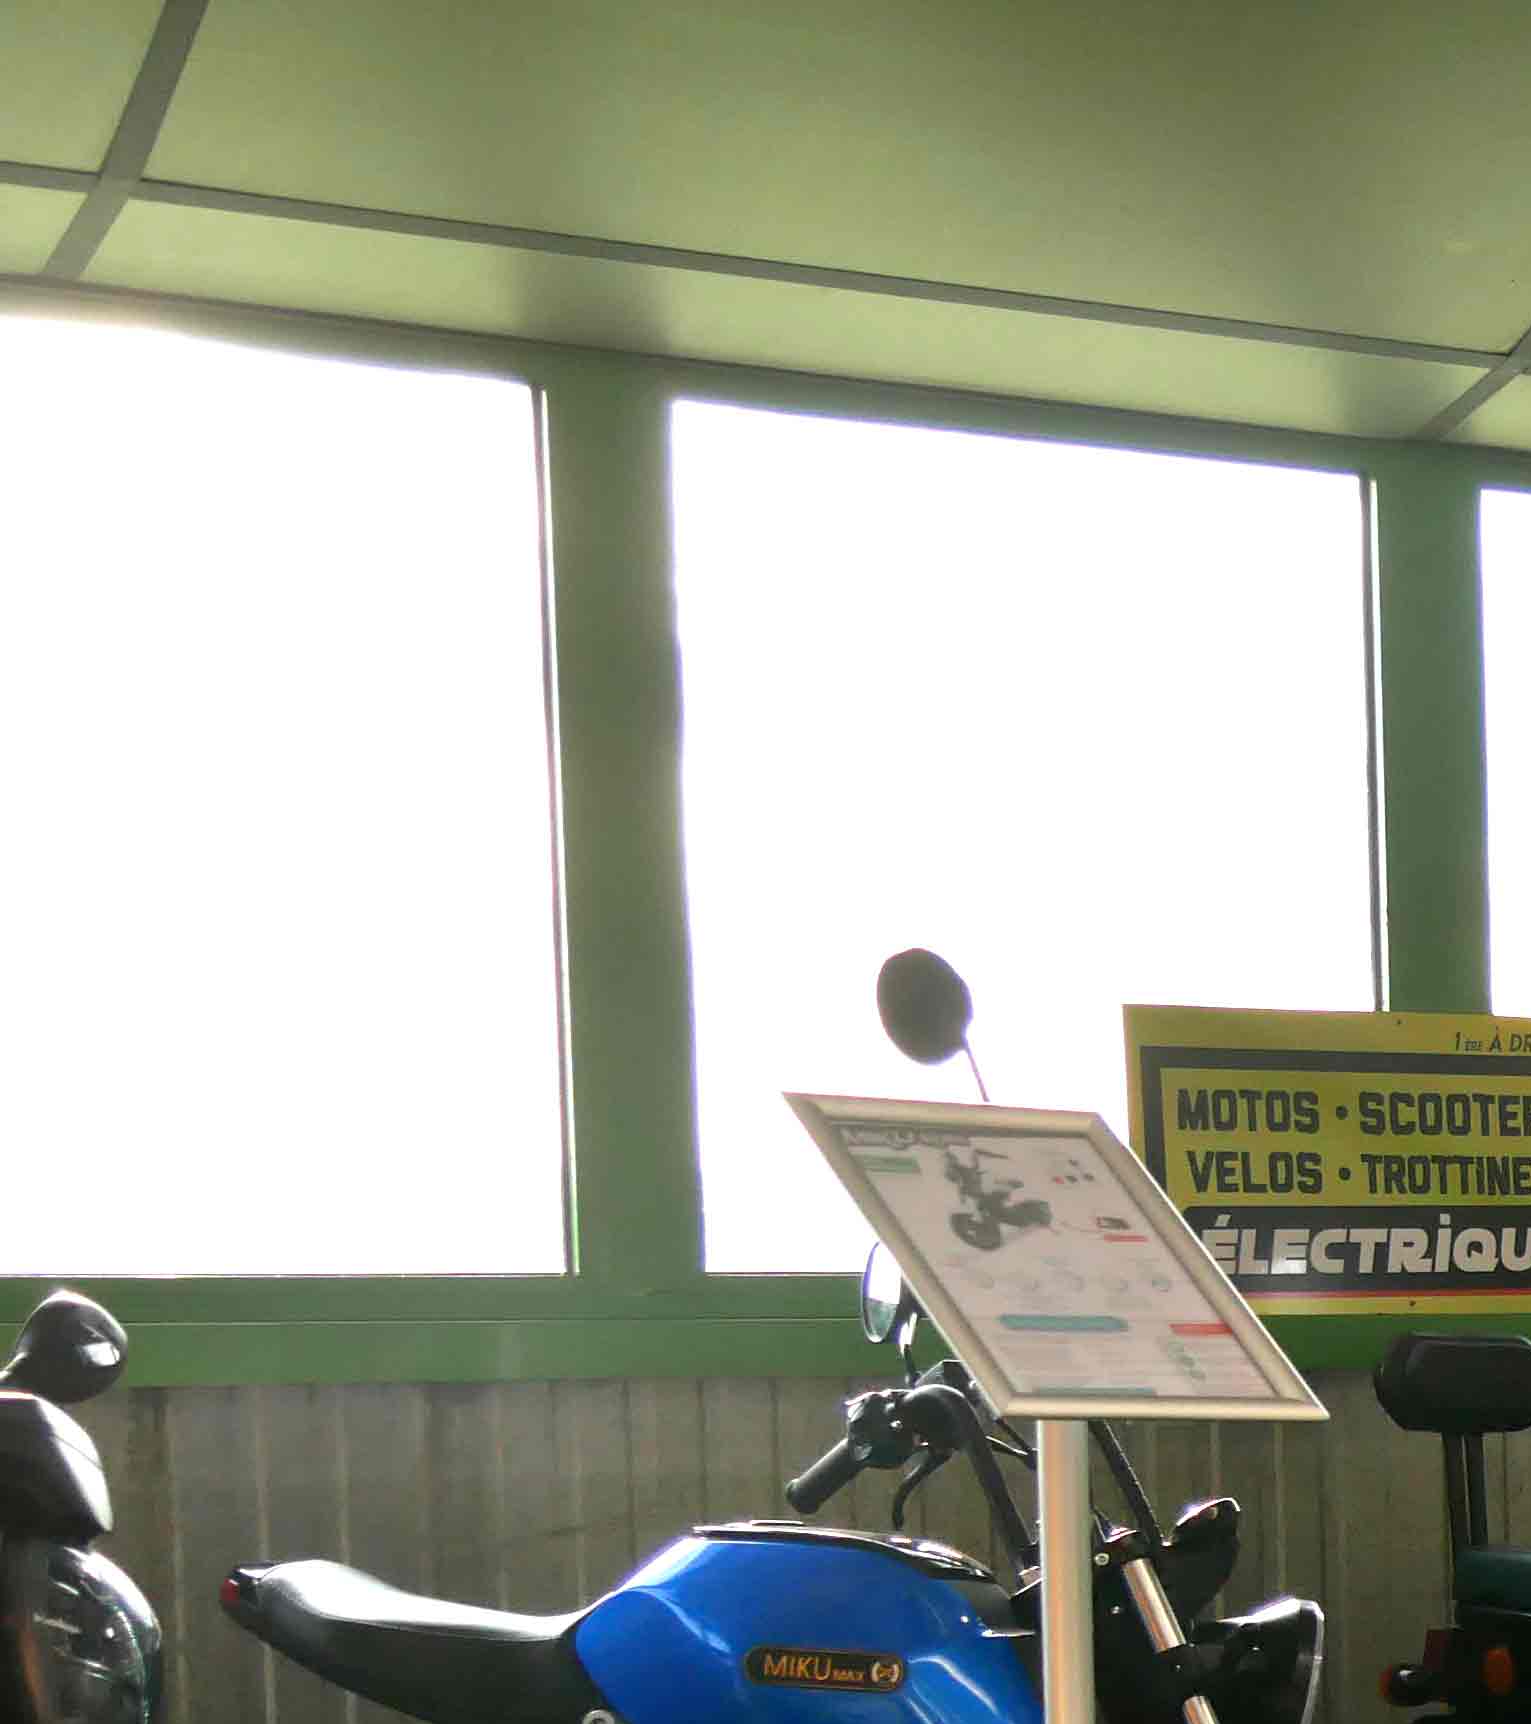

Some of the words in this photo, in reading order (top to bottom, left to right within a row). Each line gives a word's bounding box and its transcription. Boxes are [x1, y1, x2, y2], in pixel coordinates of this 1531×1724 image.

[1176, 1089, 1320, 1135] MOTOS
[1186, 1150, 1323, 1195] VELOS
[763, 1653, 832, 1681] MIKU
